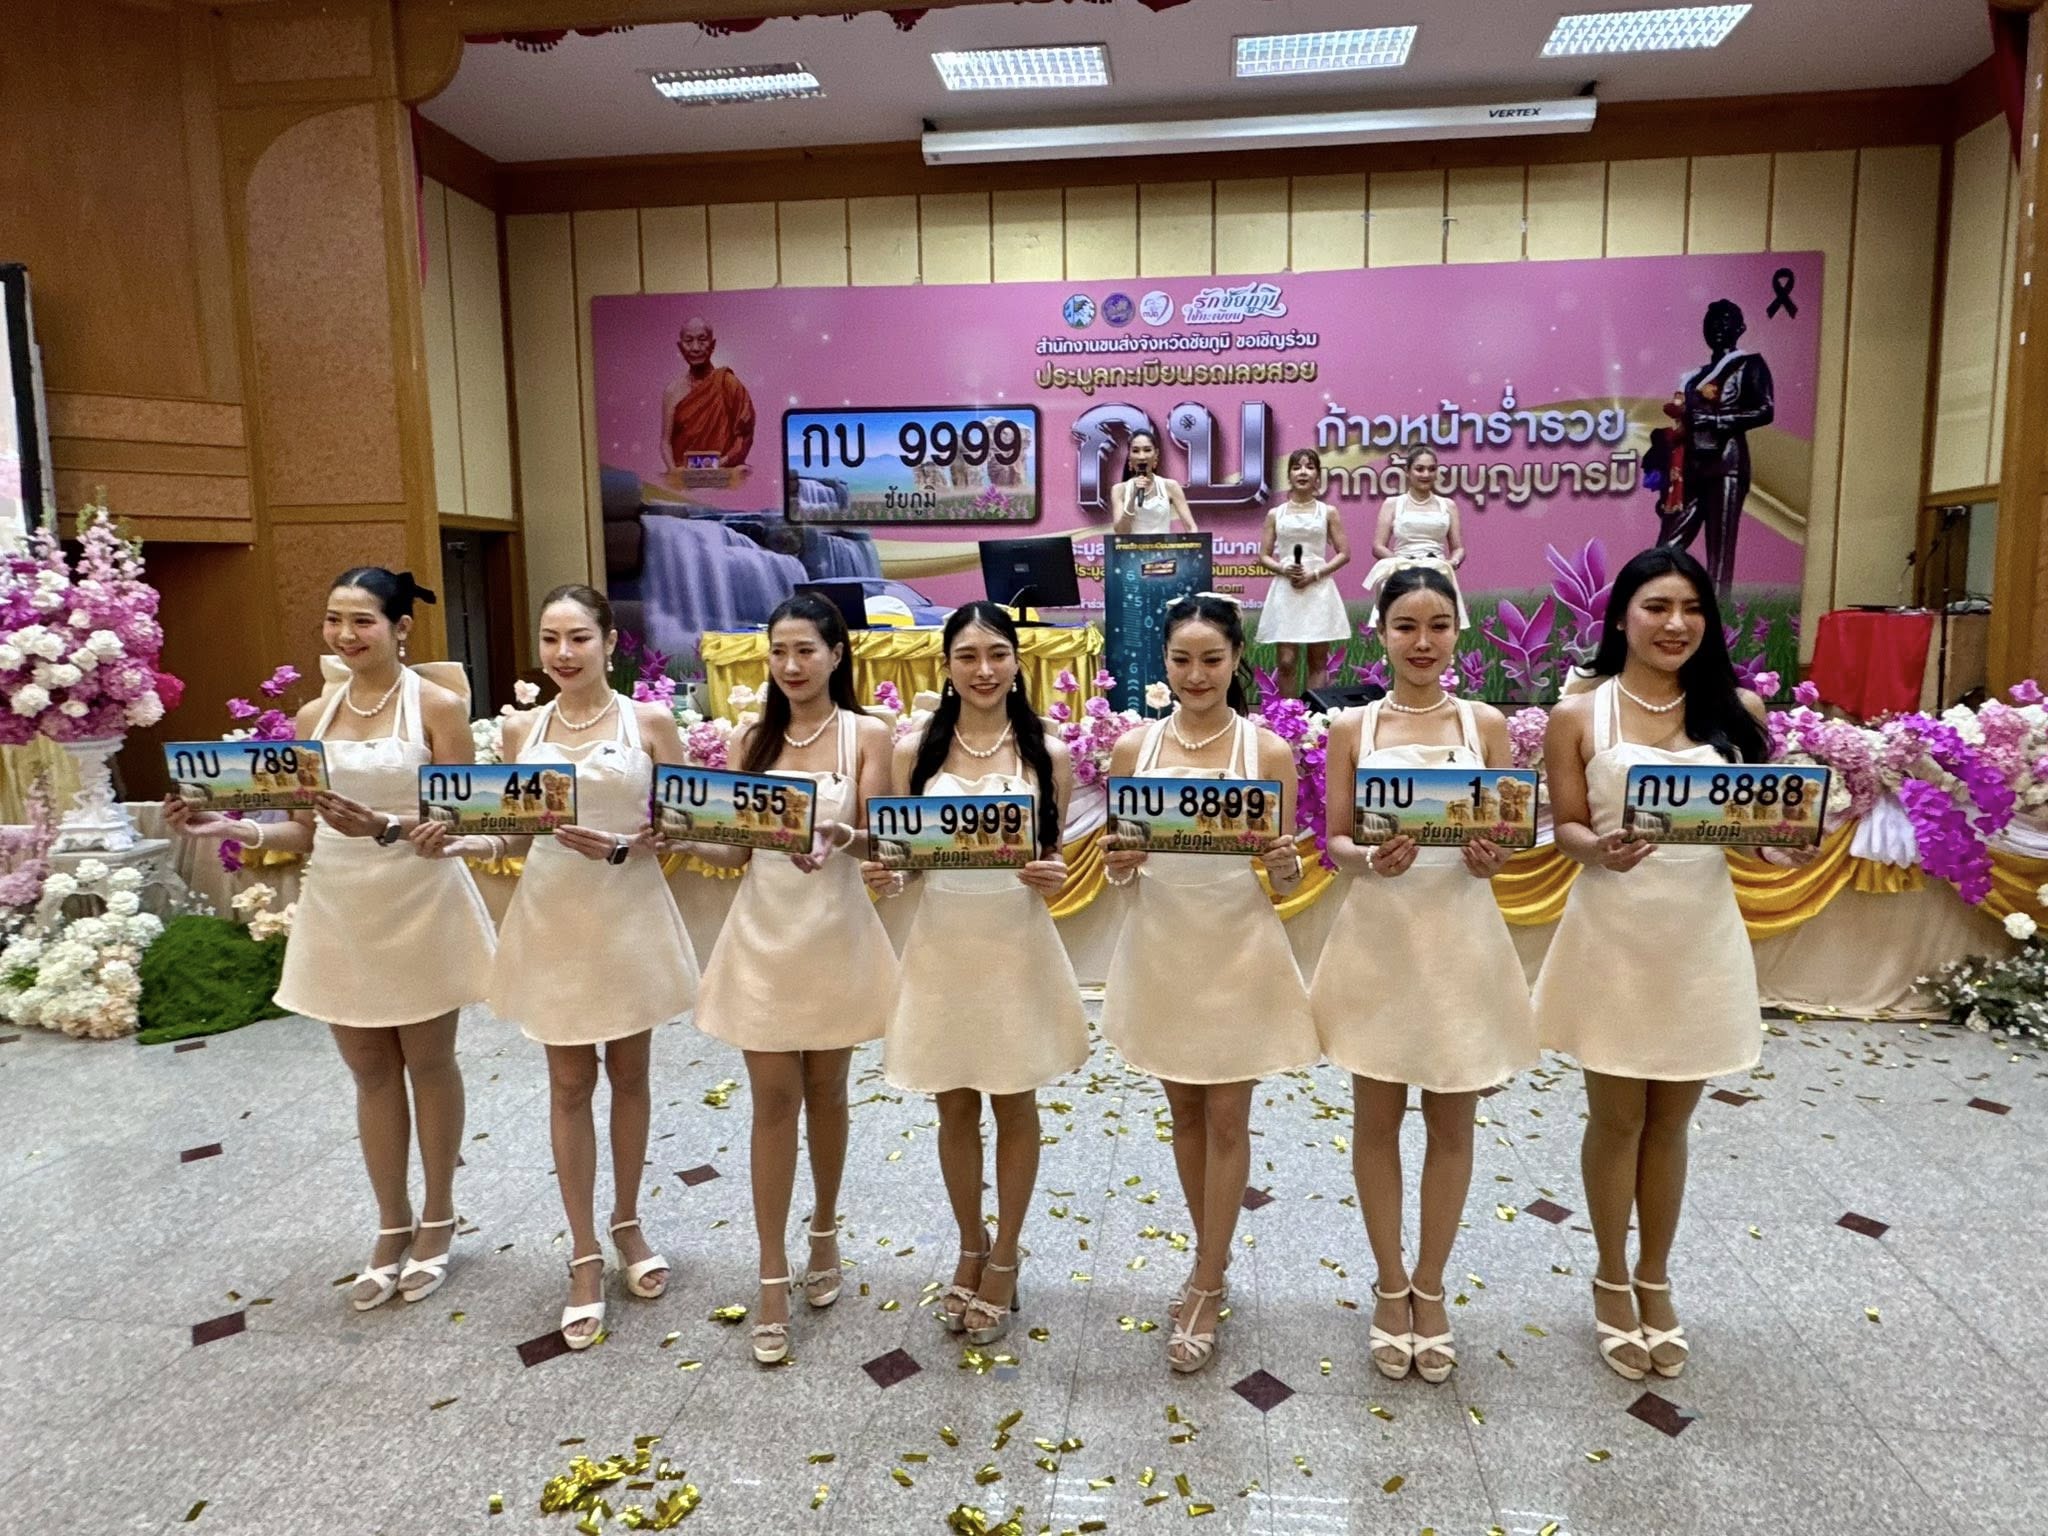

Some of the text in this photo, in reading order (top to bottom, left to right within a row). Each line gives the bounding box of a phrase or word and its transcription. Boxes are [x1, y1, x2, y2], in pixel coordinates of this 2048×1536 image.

[1489, 108, 1541, 118] VERTEX
[1036, 331, 1318, 355] สำนักงานขนส่งจังหวัดชัยภูมิ ขอเชิญร่วม
[1035, 359, 1318, 395] ประมูลทะเบียนรถเลขสวย
[1317, 385, 1626, 448] ก้าวหน้าร่ำรวย
[802, 420, 1021, 468] กบ 9999
[884, 485, 937, 515] ชัยภูมิ
[175, 747, 298, 778] กบ 789
[429, 771, 543, 801] กบ 44
[665, 774, 787, 815] กบ 555
[1118, 785, 1265, 819] กบ 8899
[1365, 776, 1481, 809] กบ 1
[1637, 773, 1804, 807] กบ 8888
[877, 803, 1022, 835] กบ 9999
[1422, 821, 1464, 840] ชัยภูมิ
[1173, 829, 1212, 849] ชัยภูมิ
